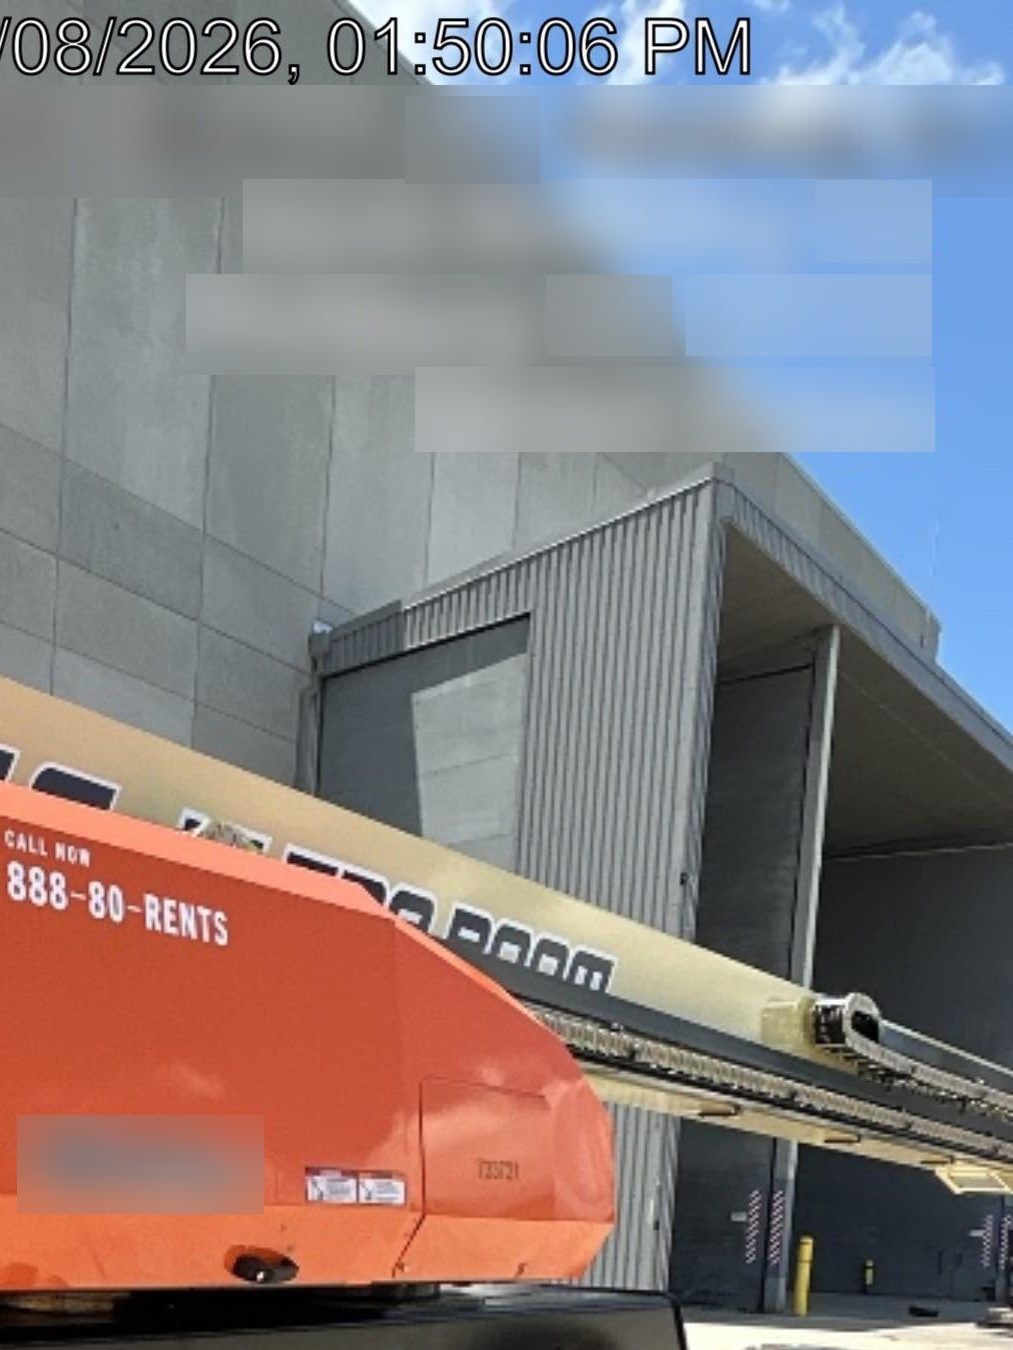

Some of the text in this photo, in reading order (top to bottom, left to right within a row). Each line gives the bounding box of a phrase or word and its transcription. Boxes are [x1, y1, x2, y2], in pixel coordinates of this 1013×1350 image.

[4, 829, 91, 868] CALL NOW
[6, 860, 230, 947] 888-80-RENTS
